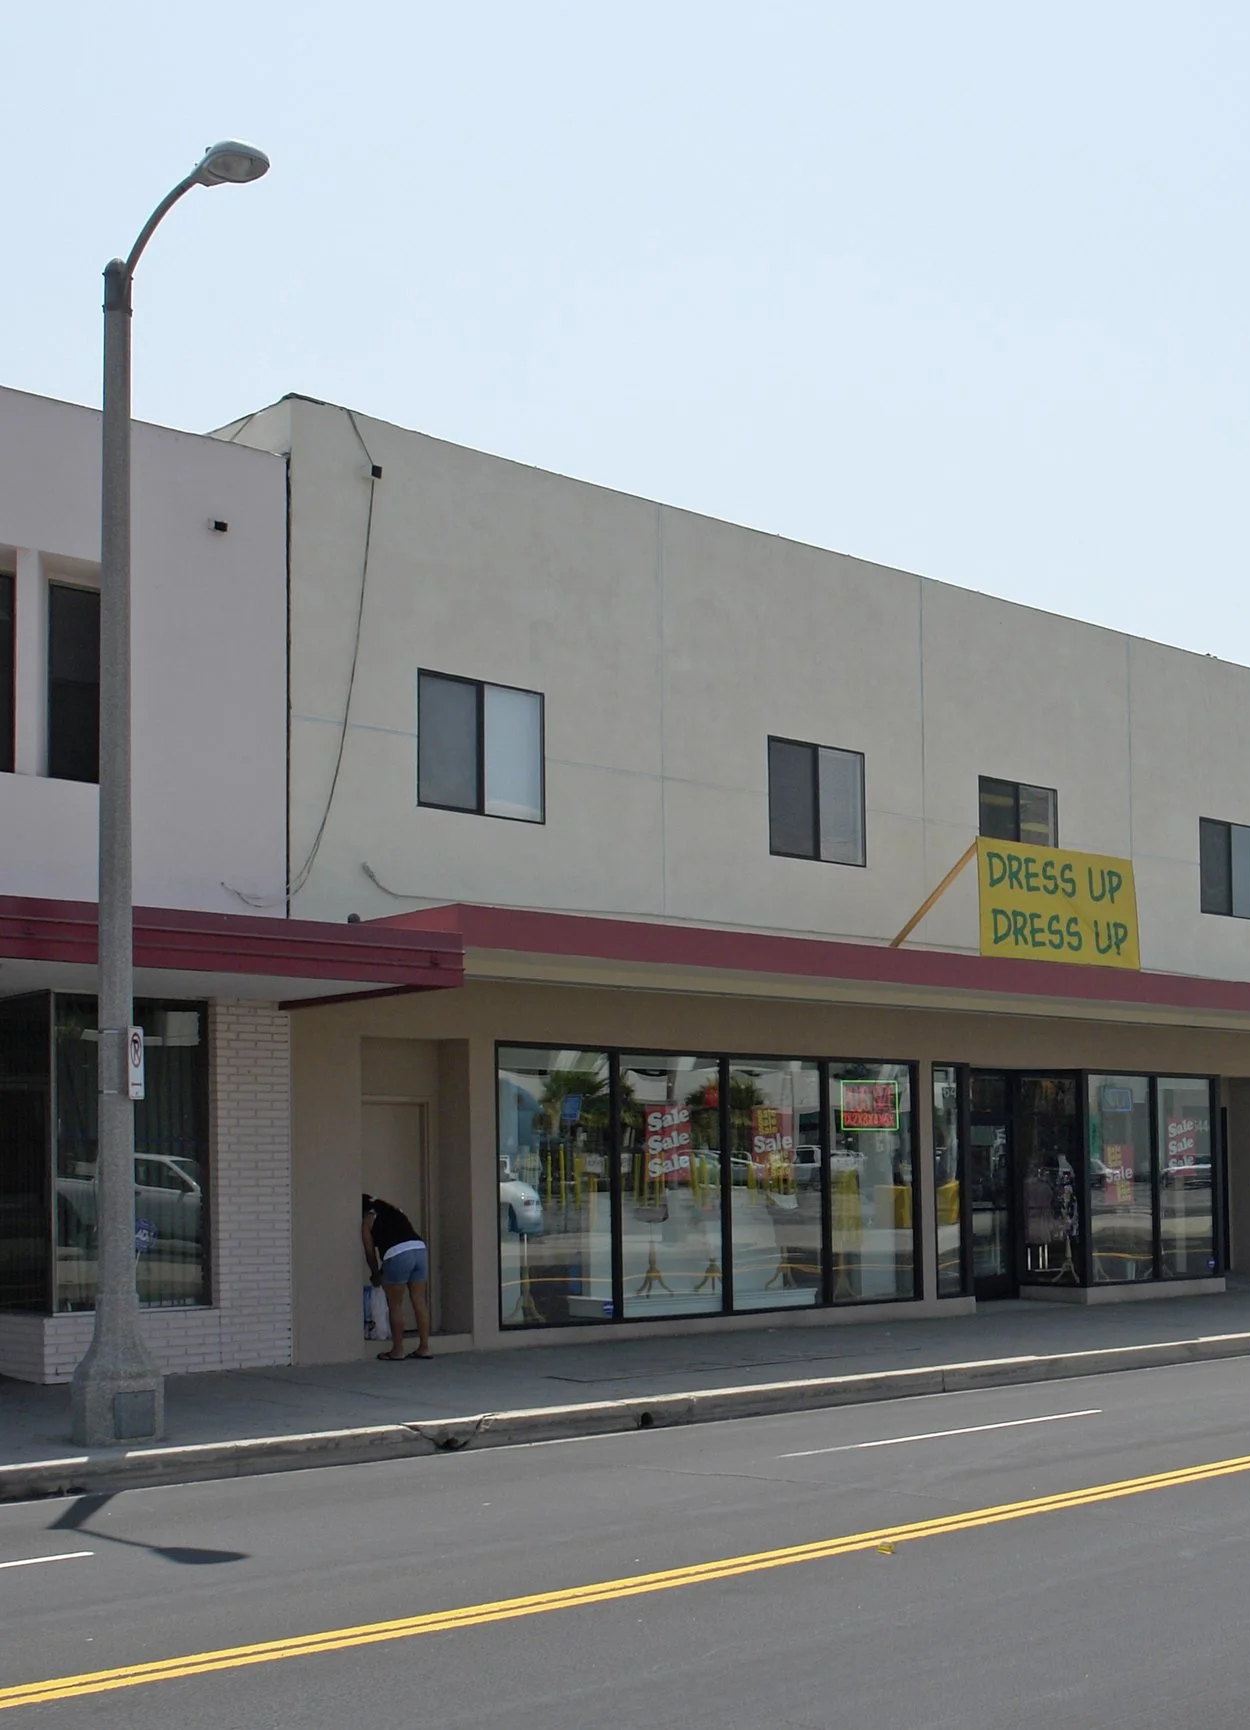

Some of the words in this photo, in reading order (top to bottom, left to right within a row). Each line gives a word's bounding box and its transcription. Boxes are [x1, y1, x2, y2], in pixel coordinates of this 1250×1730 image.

[986, 851, 1076, 898] DRESS
[1088, 866, 1123, 904] UP
[991, 908, 1083, 951] DRESS
[1093, 920, 1128, 955] UP
[647, 1108, 689, 1131] Sale
[1168, 1119, 1194, 1138] Sale
[648, 1131, 690, 1154] Sale
[754, 1133, 792, 1153] Sale
[1168, 1138, 1194, 1155] Sale
[648, 1154, 690, 1177] Sale
[1168, 1155, 1194, 1172] Sale
[1105, 1166, 1133, 1183] Sale
